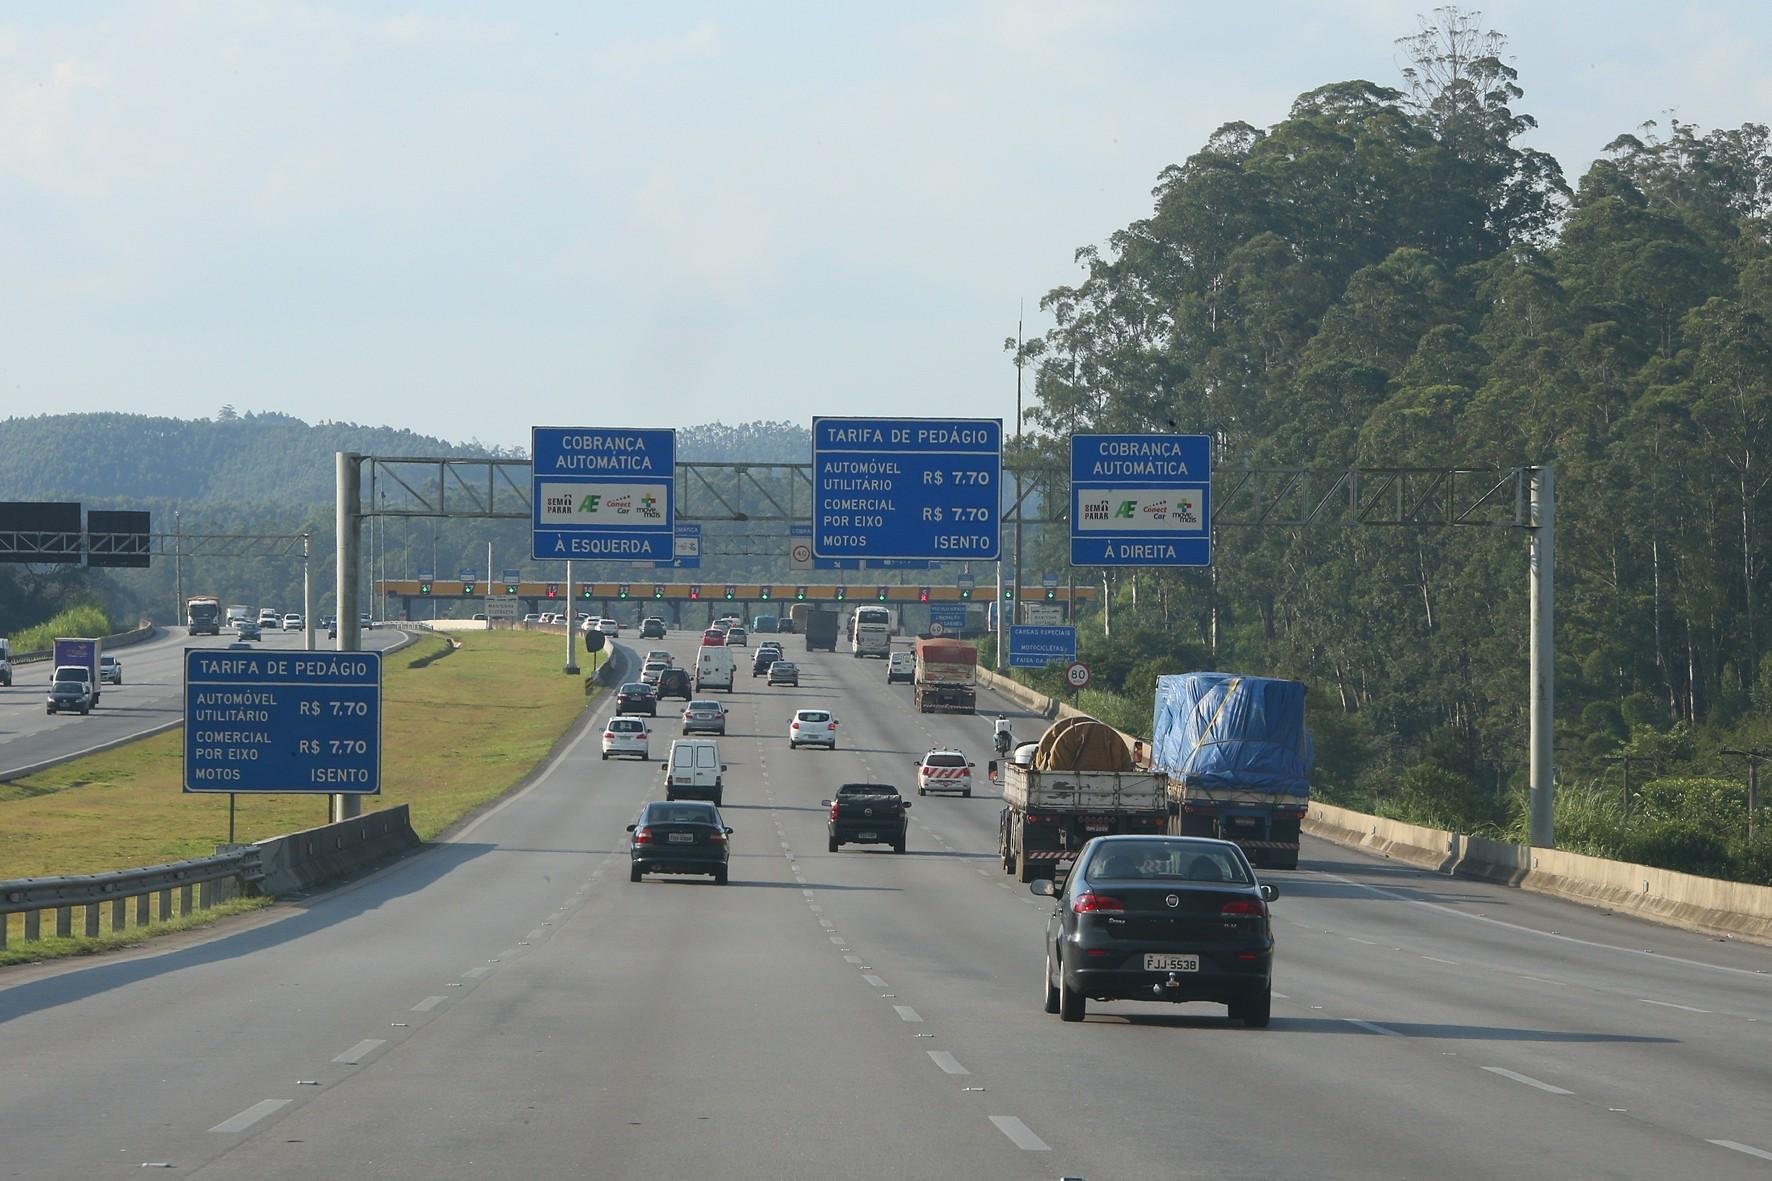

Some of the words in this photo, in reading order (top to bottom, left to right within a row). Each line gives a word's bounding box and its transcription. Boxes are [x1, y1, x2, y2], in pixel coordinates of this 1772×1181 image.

[828, 429, 883, 443] TARIFA
[891, 430, 910, 443] DE
[918, 426, 988, 444] PEDÁGIO
[562, 436, 645, 452] COBRANÇA
[1099, 442, 1182, 458] COBRANÇA
[556, 451, 652, 470] AUTOMÁTICA
[824, 458, 901, 474] AUTOMÓVEL
[1093, 457, 1188, 475] AUTOMÁTICA
[824, 476, 892, 491] UTILITÁRIO
[923, 471, 943, 486] R$
[547, 498, 564, 506] SEM
[607, 500, 631, 508] Conect
[824, 499, 895, 511] COMERCIAL
[1084, 504, 1101, 512] SEM
[547, 505, 572, 514] PARAR
[923, 507, 943, 522] R$
[1084, 512, 1109, 520] PARAR
[824, 516, 849, 527] POR
[855, 516, 883, 527] EIXO
[555, 534, 565, 552] À
[571, 539, 652, 554] ESQUERDA
[823, 536, 867, 546] MOTOS
[934, 536, 989, 549] ISENTO
[1104, 540, 1115, 558] À
[1120, 545, 1176, 559] DIREITA
[200, 660, 259, 675] TARIFA
[267, 661, 288, 675] DE
[296, 657, 366, 676] PEDÁGIO
[1071, 669, 1086, 679] 80
[197, 690, 278, 705] AUTOMÓVEL
[196, 706, 268, 721] UTILITÁRIO
[300, 701, 320, 716] R$
[330, 702, 368, 716] 7,70
[196, 731, 272, 743] COMERCIAL
[300, 740, 320, 754] R$
[329, 741, 367, 754] 7,70
[196, 749, 222, 760] POR
[229, 749, 258, 760] EIXO
[196, 768, 240, 780] MOTOS
[312, 769, 368, 782] ISENTO
